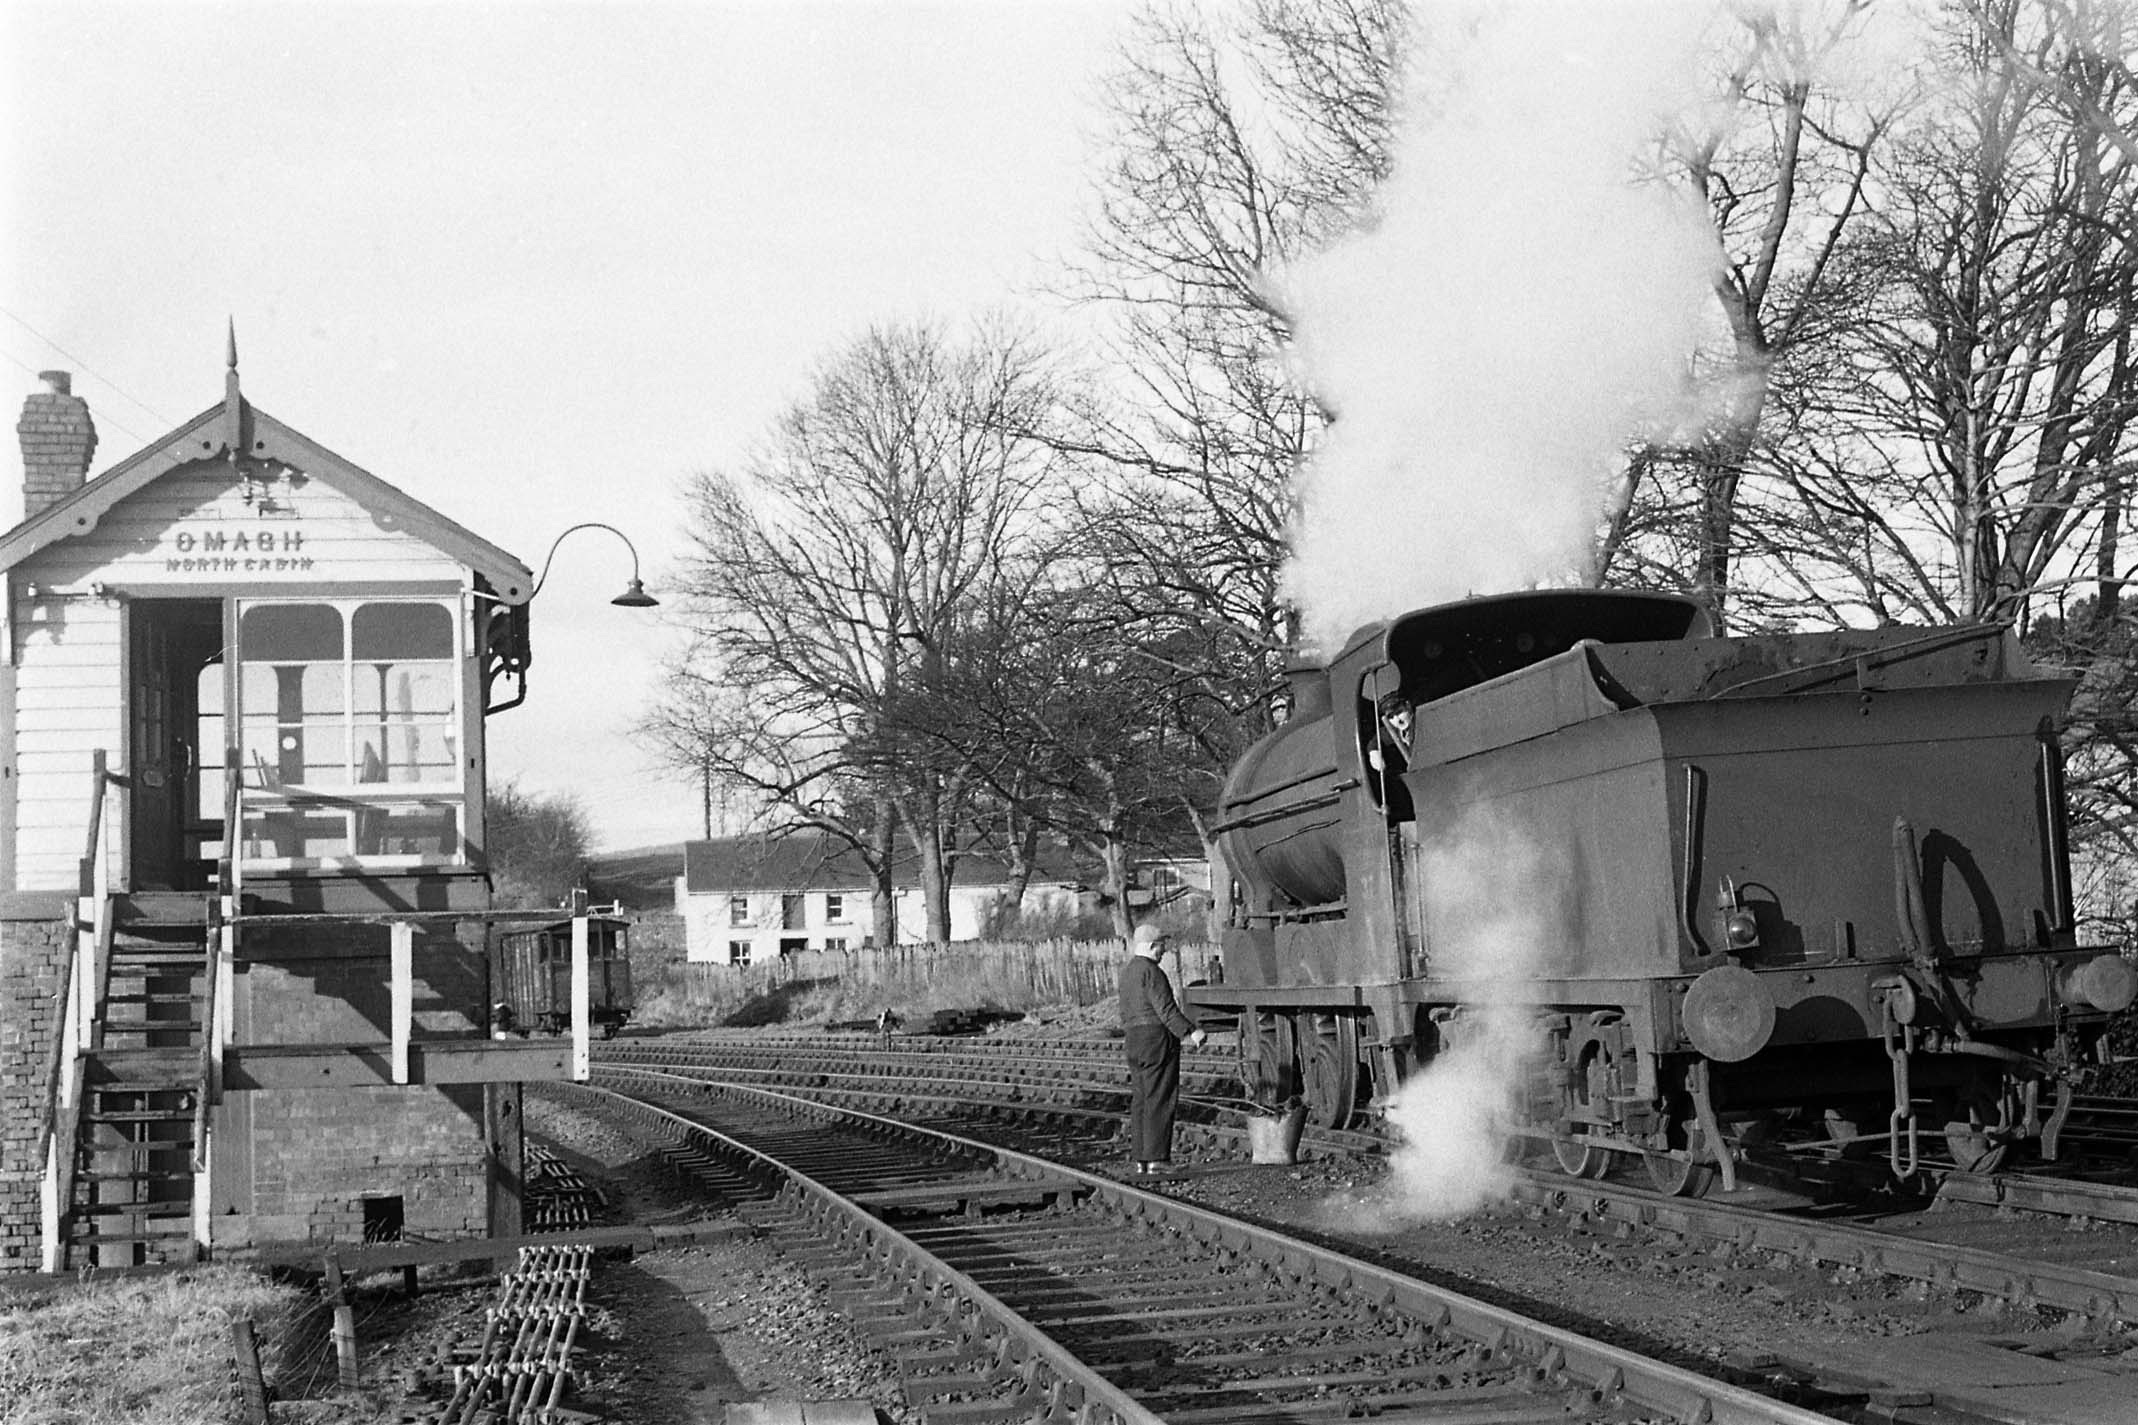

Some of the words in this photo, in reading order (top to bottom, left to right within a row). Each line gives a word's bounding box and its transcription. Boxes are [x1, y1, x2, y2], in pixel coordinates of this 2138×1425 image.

[176, 531, 303, 552] OMAGH
[166, 557, 237, 572] NORTH
[244, 557, 314, 572] CABIN
